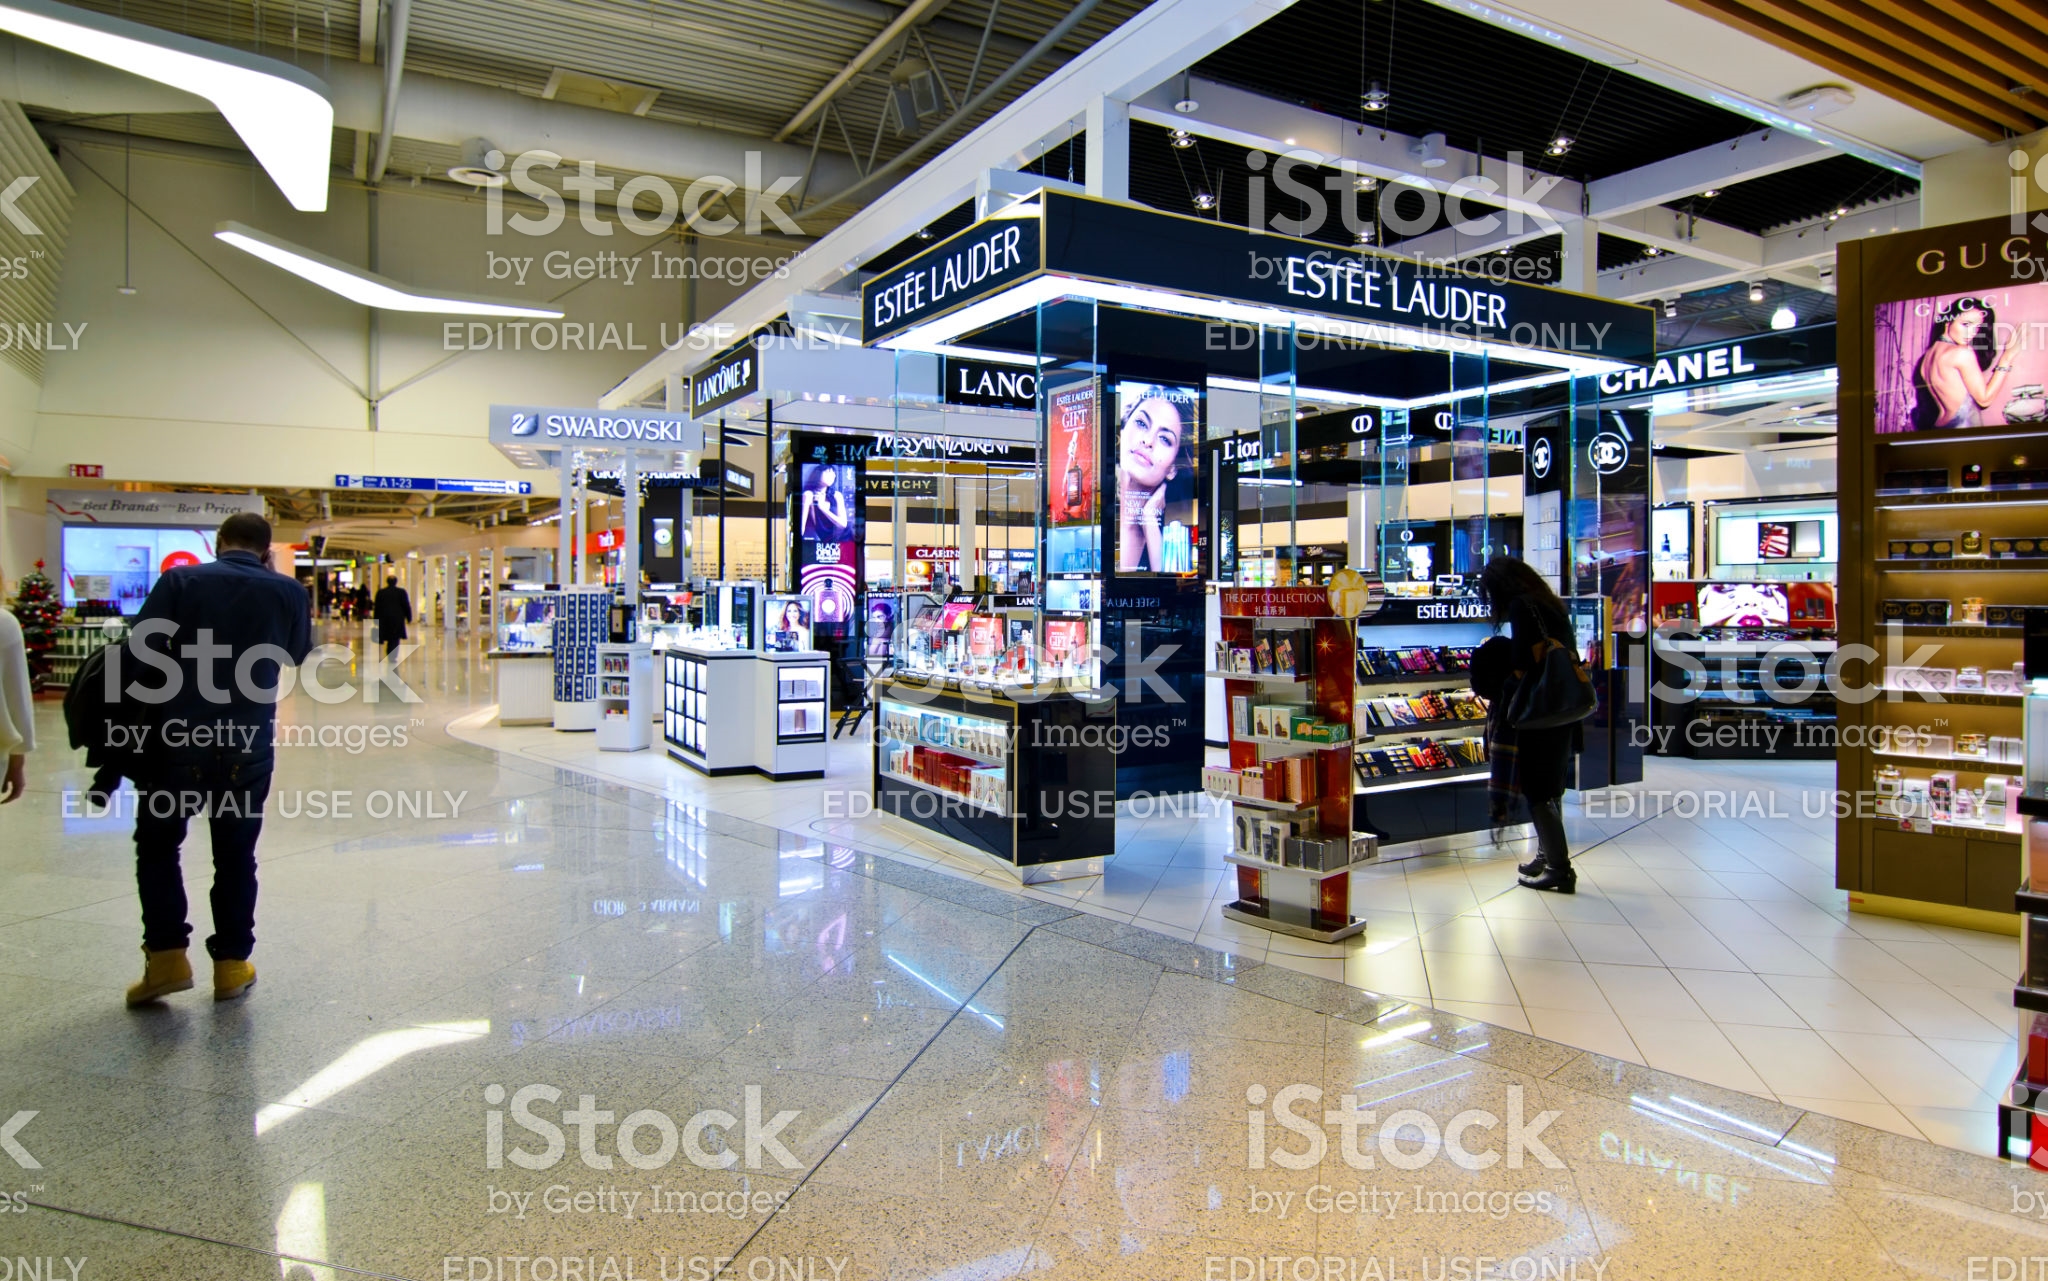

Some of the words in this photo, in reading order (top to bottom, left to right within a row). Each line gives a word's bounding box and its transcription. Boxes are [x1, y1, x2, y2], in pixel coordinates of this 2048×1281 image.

[931, 225, 1021, 302] LAUDER
[1916, 236, 2048, 276] GUC
[1392, 276, 1507, 329] LAUDER
[1914, 293, 2009, 317] GUCCI
[1599, 345, 1755, 395] CHANEL
[1154, 391, 1189, 404] LAUDER
[1062, 408, 1088, 428] GIFT
[546, 415, 683, 442] SWAROVSKI
[379, 477, 388, 488] A
[391, 478, 412, 489] 1-23
[866, 480, 932, 489] IVENCHY
[83, 501, 108, 511] Best
[110, 499, 160, 512] Brands
[1125, 507, 1162, 515] DIMENON
[1225, 593, 1239, 603] THE
[1240, 593, 1260, 603] GIFT
[1261, 592, 1325, 604] COLLECTION
[1450, 603, 1492, 619] LAUDER
